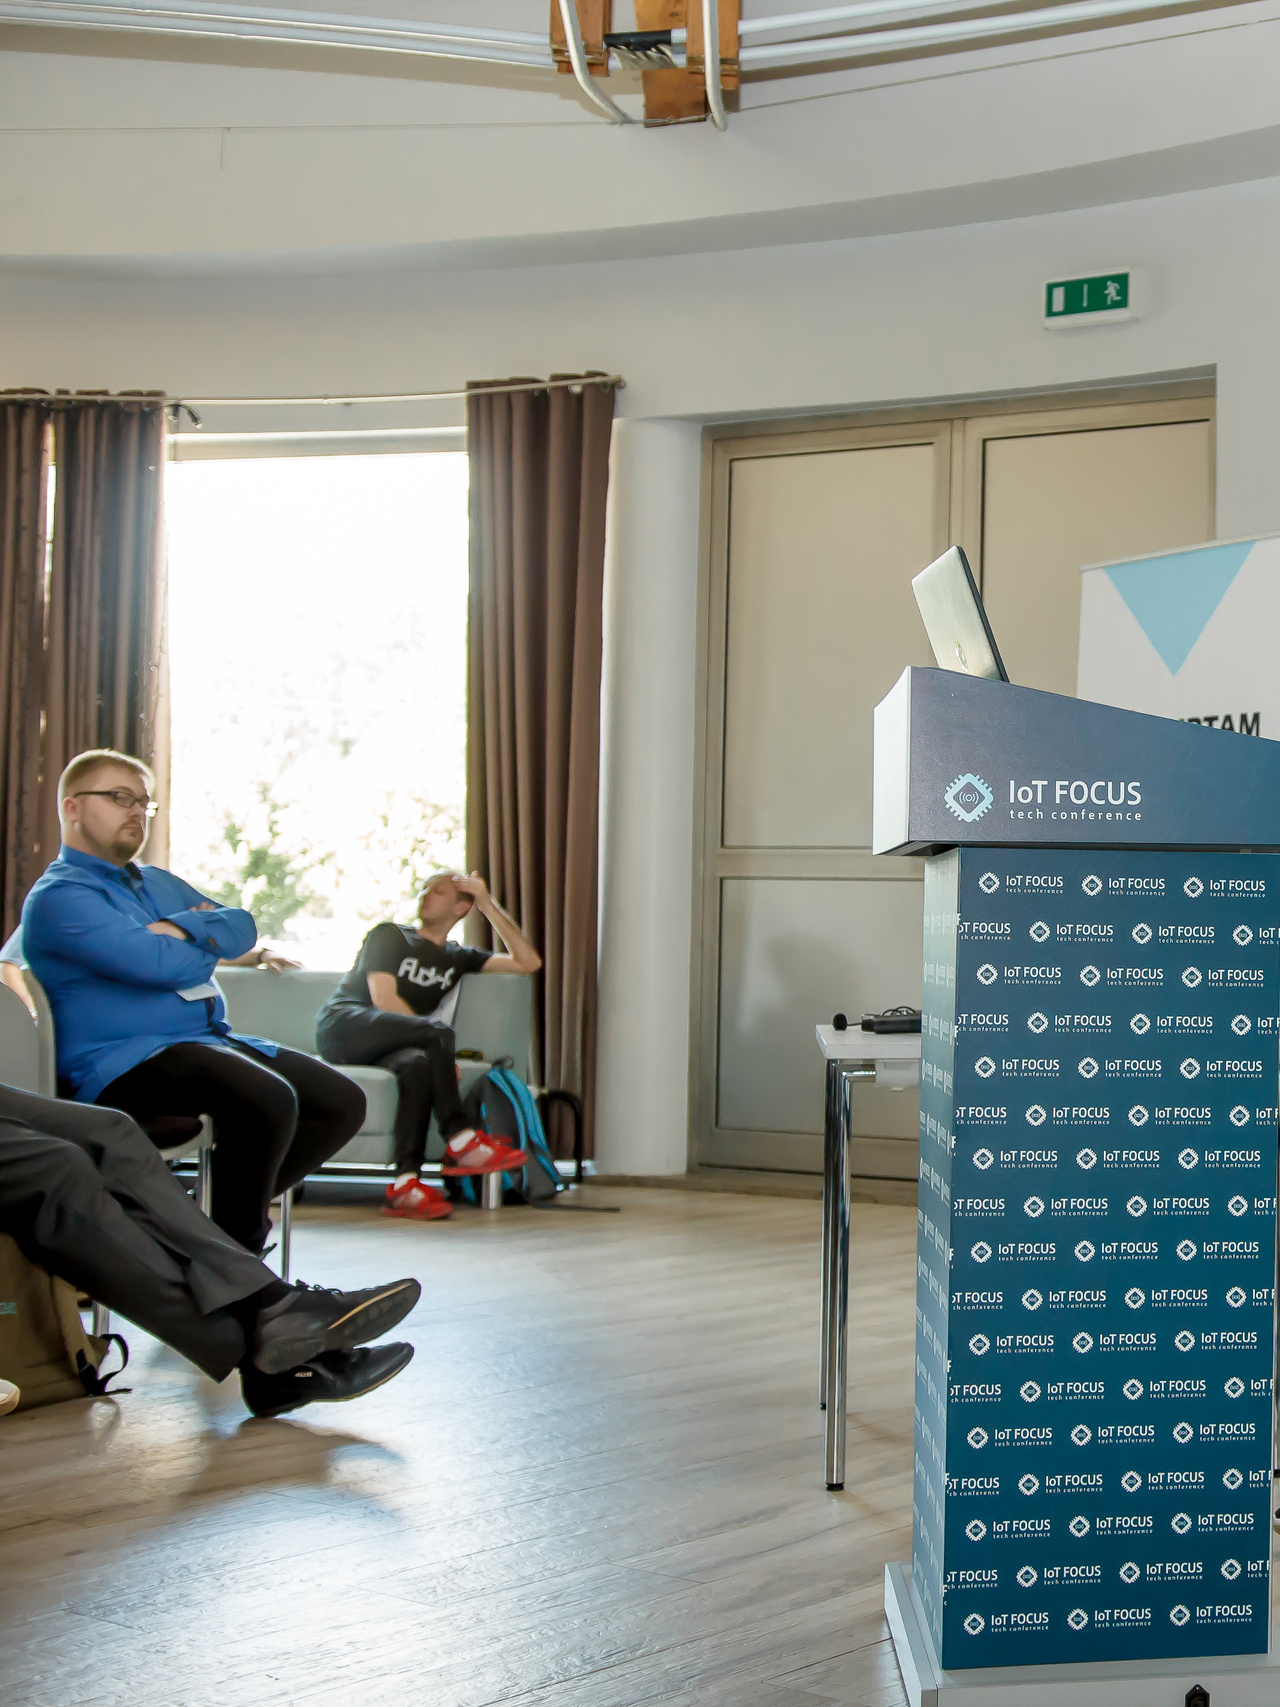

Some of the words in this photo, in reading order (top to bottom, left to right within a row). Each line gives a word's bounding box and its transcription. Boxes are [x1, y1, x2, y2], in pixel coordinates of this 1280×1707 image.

[1009, 780, 1048, 805] IoT
[1055, 780, 1142, 805] FOCUS
[1009, 807, 1044, 821] tech
[1051, 808, 1142, 821] conference
[1006, 875, 1024, 886] IoT
[1025, 875, 1064, 887] FOCUS
[1108, 877, 1126, 889] IoT
[1128, 877, 1166, 890] FOCUS
[1210, 879, 1227, 891] IoT
[1228, 879, 1266, 892] FOCUS
[972, 922, 1011, 934] FOCUS
[1056, 923, 1074, 935] IoT
[1075, 924, 1114, 936] FOCUS
[1158, 925, 1176, 937] IoT
[1177, 926, 1215, 938] FOCUS
[1004, 966, 1022, 978] IoT
[1023, 966, 1062, 978] FOCUS
[1107, 967, 1124, 979] IoT
[1126, 968, 1164, 980] FOCUS
[1208, 969, 1226, 980] IoT
[1227, 969, 1264, 981] FOCUS
[970, 1013, 1009, 1026] FOCUS
[1054, 1014, 1072, 1026] IoT
[1074, 1014, 1112, 1027] FOCUS
[1156, 1015, 1174, 1027] IoT
[1175, 1016, 1213, 1028] FOCUS
[1002, 1058, 1020, 1070] IoT
[1021, 1058, 1060, 1071] FOCUS
[1105, 1059, 1123, 1071] IoT
[1124, 1059, 1162, 1071] FOCUS
[1206, 1060, 1224, 1072] IoT
[1225, 1060, 1263, 1072] FOCUS
[968, 1106, 1007, 1118] FOCUS
[1052, 1107, 1071, 1118] IoT
[1072, 1107, 1110, 1119] FOCUS
[1155, 1107, 1172, 1119] IoT
[1174, 1107, 1212, 1119] FOCUS
[1000, 1150, 1018, 1162] IoT
[1020, 1150, 1058, 1162] FOCUS
[1103, 1150, 1121, 1162] IoT
[1122, 1150, 1160, 1162] FOCUS
[1204, 1150, 1222, 1162] IoT
[1223, 1150, 1261, 1162] FOCUS
[966, 1198, 1005, 1210] FOCUS
[1051, 1198, 1069, 1210] IoT
[1070, 1197, 1108, 1210] FOCUS
[1153, 1197, 1171, 1209] IoT
[1172, 1197, 1210, 1209] FOCUS
[998, 1243, 1016, 1255] IoT
[1018, 1242, 1056, 1255] FOCUS
[1101, 1242, 1119, 1254] IoT
[1120, 1242, 1159, 1254] FOCUS
[1203, 1241, 1220, 1253] IoT
[1222, 1241, 1259, 1253] FOCUS
[964, 1291, 1004, 1303] FOCUS
[1049, 1290, 1067, 1302] IoT
[1068, 1290, 1107, 1302] FOCUS
[1151, 1289, 1169, 1301] IoT
[1170, 1289, 1208, 1301] FOCUS
[996, 1335, 1014, 1347] IoT
[1016, 1334, 1054, 1347] FOCUS
[1099, 1333, 1117, 1345] IoT
[1119, 1333, 1157, 1345] FOCUS
[1201, 1332, 1219, 1344] IoT
[1220, 1331, 1258, 1343] FOCUS
[963, 1383, 1002, 1396] FOCUS
[1047, 1382, 1065, 1394] IoT
[1066, 1381, 1105, 1394] FOCUS
[1149, 1380, 1167, 1392] IoT
[1169, 1379, 1207, 1392] FOCUS
[994, 1428, 1012, 1440] IoT
[1014, 1427, 1053, 1440] FOCUS
[1098, 1426, 1115, 1437] IoT
[1117, 1424, 1155, 1437] FOCUS
[1199, 1423, 1217, 1435] IoT
[1218, 1423, 1256, 1435] FOCUS
[961, 1477, 1000, 1490] FOCUS
[1045, 1475, 1063, 1487] IoT
[1065, 1474, 1103, 1486] FOCUS
[1148, 1472, 1165, 1484] IoT
[1167, 1471, 1205, 1483] FOCUS
[993, 1520, 1011, 1532] IoT
[1012, 1519, 1051, 1532] FOCUS
[1096, 1517, 1114, 1529] IoT
[1115, 1515, 1153, 1528] FOCUS
[1198, 1514, 1215, 1526] IoT
[1217, 1513, 1254, 1525] FOCUS
[1044, 1566, 1061, 1579] IoT
[1063, 1565, 1101, 1578] FOCUS
[1146, 1563, 1164, 1575] IoT
[1165, 1562, 1203, 1574] FOCUS
[959, 1569, 998, 1582] FOCUS
[1094, 1609, 1112, 1621] IoT
[1114, 1608, 1152, 1621] FOCUS
[1196, 1606, 1214, 1617] IoT
[1215, 1604, 1253, 1617] FOCUS
[991, 1614, 1009, 1626] IoT
[1011, 1612, 1049, 1625] FOCUS
